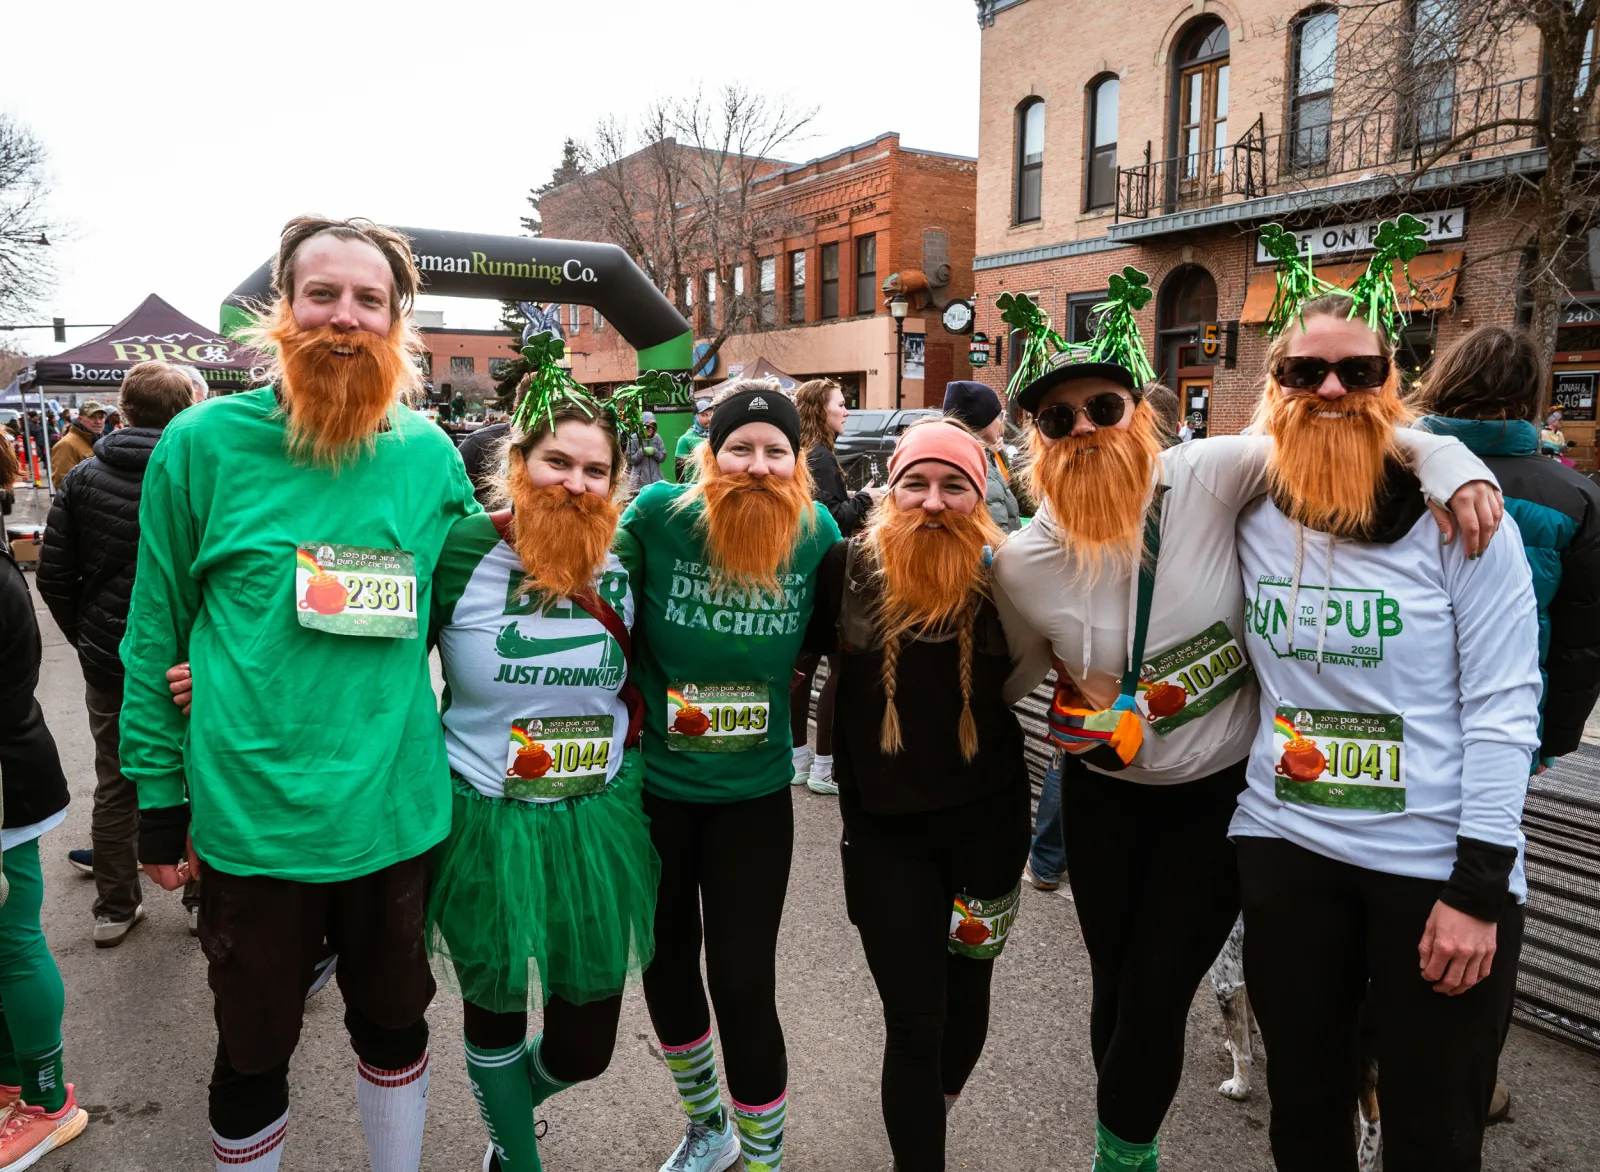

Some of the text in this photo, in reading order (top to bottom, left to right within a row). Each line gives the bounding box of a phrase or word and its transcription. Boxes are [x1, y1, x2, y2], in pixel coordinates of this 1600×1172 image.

[1322, 228, 1356, 249] ON
[412, 251, 598, 285] emanRunningCo.
[1566, 311, 1594, 323] 240
[344, 576, 413, 612] 2381
[502, 569, 629, 622] BR
[664, 598, 801, 635] MACHINE
[1244, 597, 1403, 638] RUN PUB
[1298, 617, 1317, 626] THE
[1301, 606, 1314, 615] TO
[1351, 645, 1378, 656] 2025
[1362, 660, 1380, 669] MT
[493, 664, 543, 686] JUST
[1177, 645, 1243, 697] 1040
[709, 705, 767, 732] 1043
[552, 741, 610, 773] 1044
[1325, 741, 1400, 782] 1041
